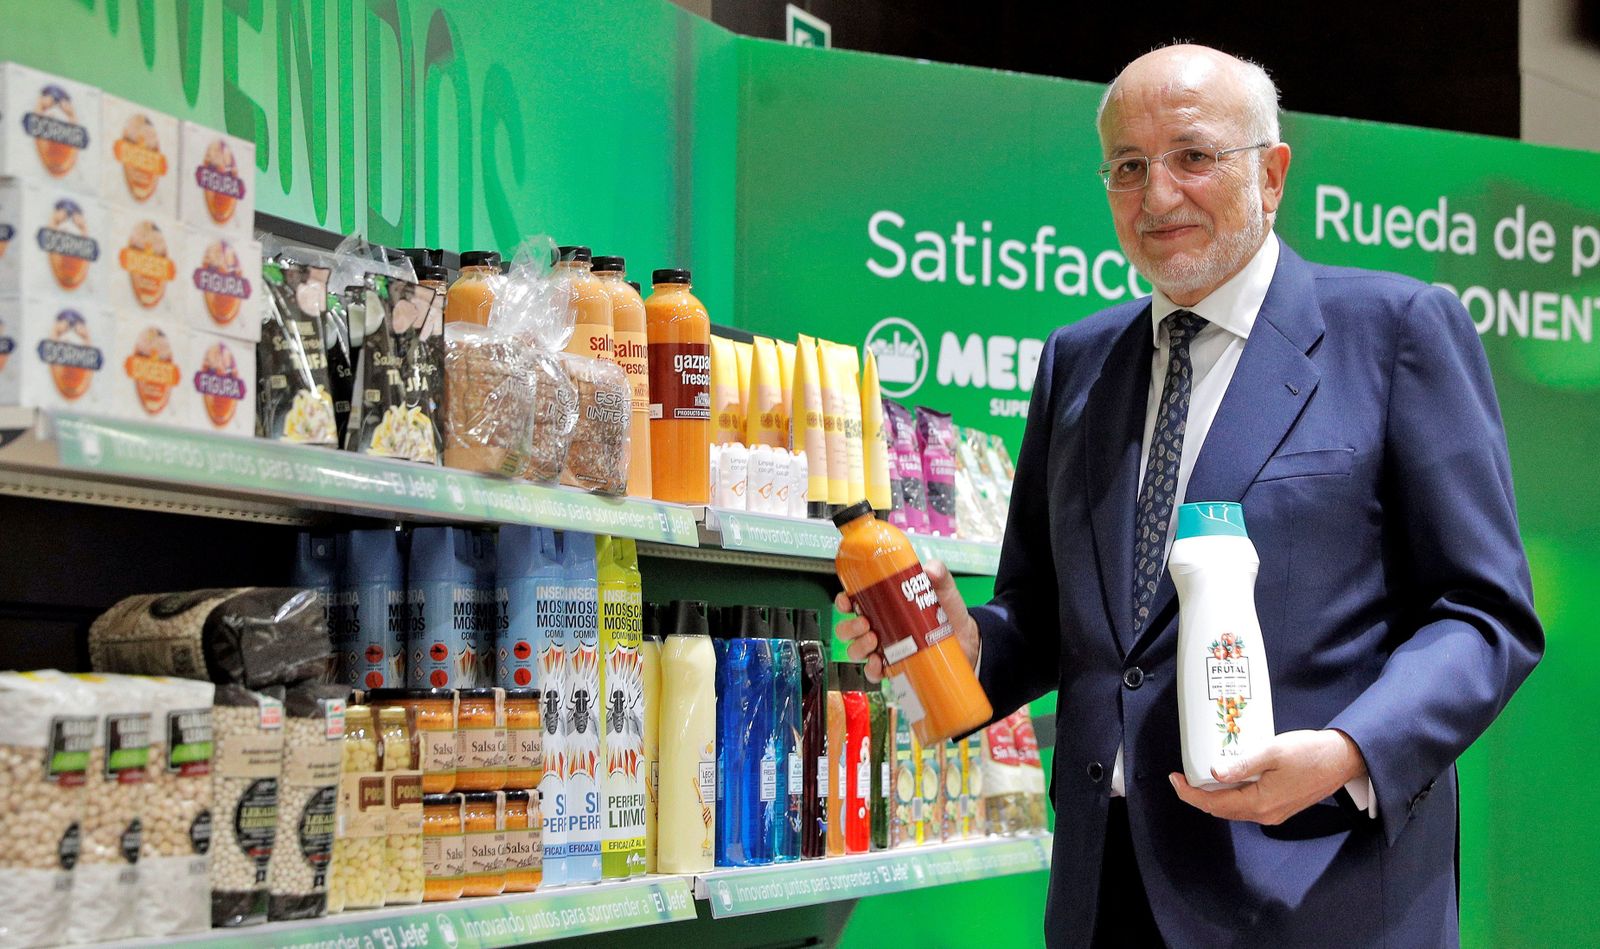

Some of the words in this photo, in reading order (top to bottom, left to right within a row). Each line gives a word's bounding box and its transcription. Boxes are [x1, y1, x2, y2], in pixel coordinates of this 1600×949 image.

[199, 169, 242, 199] FIGURA
[1315, 183, 1477, 255] Rueda
[1494, 203, 1557, 264] de
[200, 270, 246, 297] FIGURA
[200, 374, 243, 399] FIGURA
[206, 447, 257, 476] juntos
[257, 458, 293, 480] para
[470, 484, 531, 514] Innovando
[532, 493, 568, 518] juntos
[568, 503, 592, 521] para
[592, 507, 646, 529] sorprender
[747, 525, 793, 546] Innovando
[794, 527, 819, 550] juntos
[1211, 665, 1246, 674] FRUTAL
[472, 740, 496, 753] Salsa
[521, 740, 540, 753] Salsa
[472, 845, 496, 857] Salsa
[506, 842, 530, 854] Salsa
[569, 843, 593, 854] EFICAZ
[736, 876, 784, 902] Innovando
[782, 878, 812, 900] juntos
[812, 875, 832, 895] para
[831, 867, 872, 892] sorprender
[460, 911, 525, 939] Innovando
[525, 907, 561, 934] juntos
[561, 906, 587, 931] para
[588, 897, 642, 924] sorprender
[642, 903, 649, 916] a
[648, 892, 665, 914] "El
[666, 888, 689, 912] Jefe"
[400, 922, 432, 949] Jefe"
